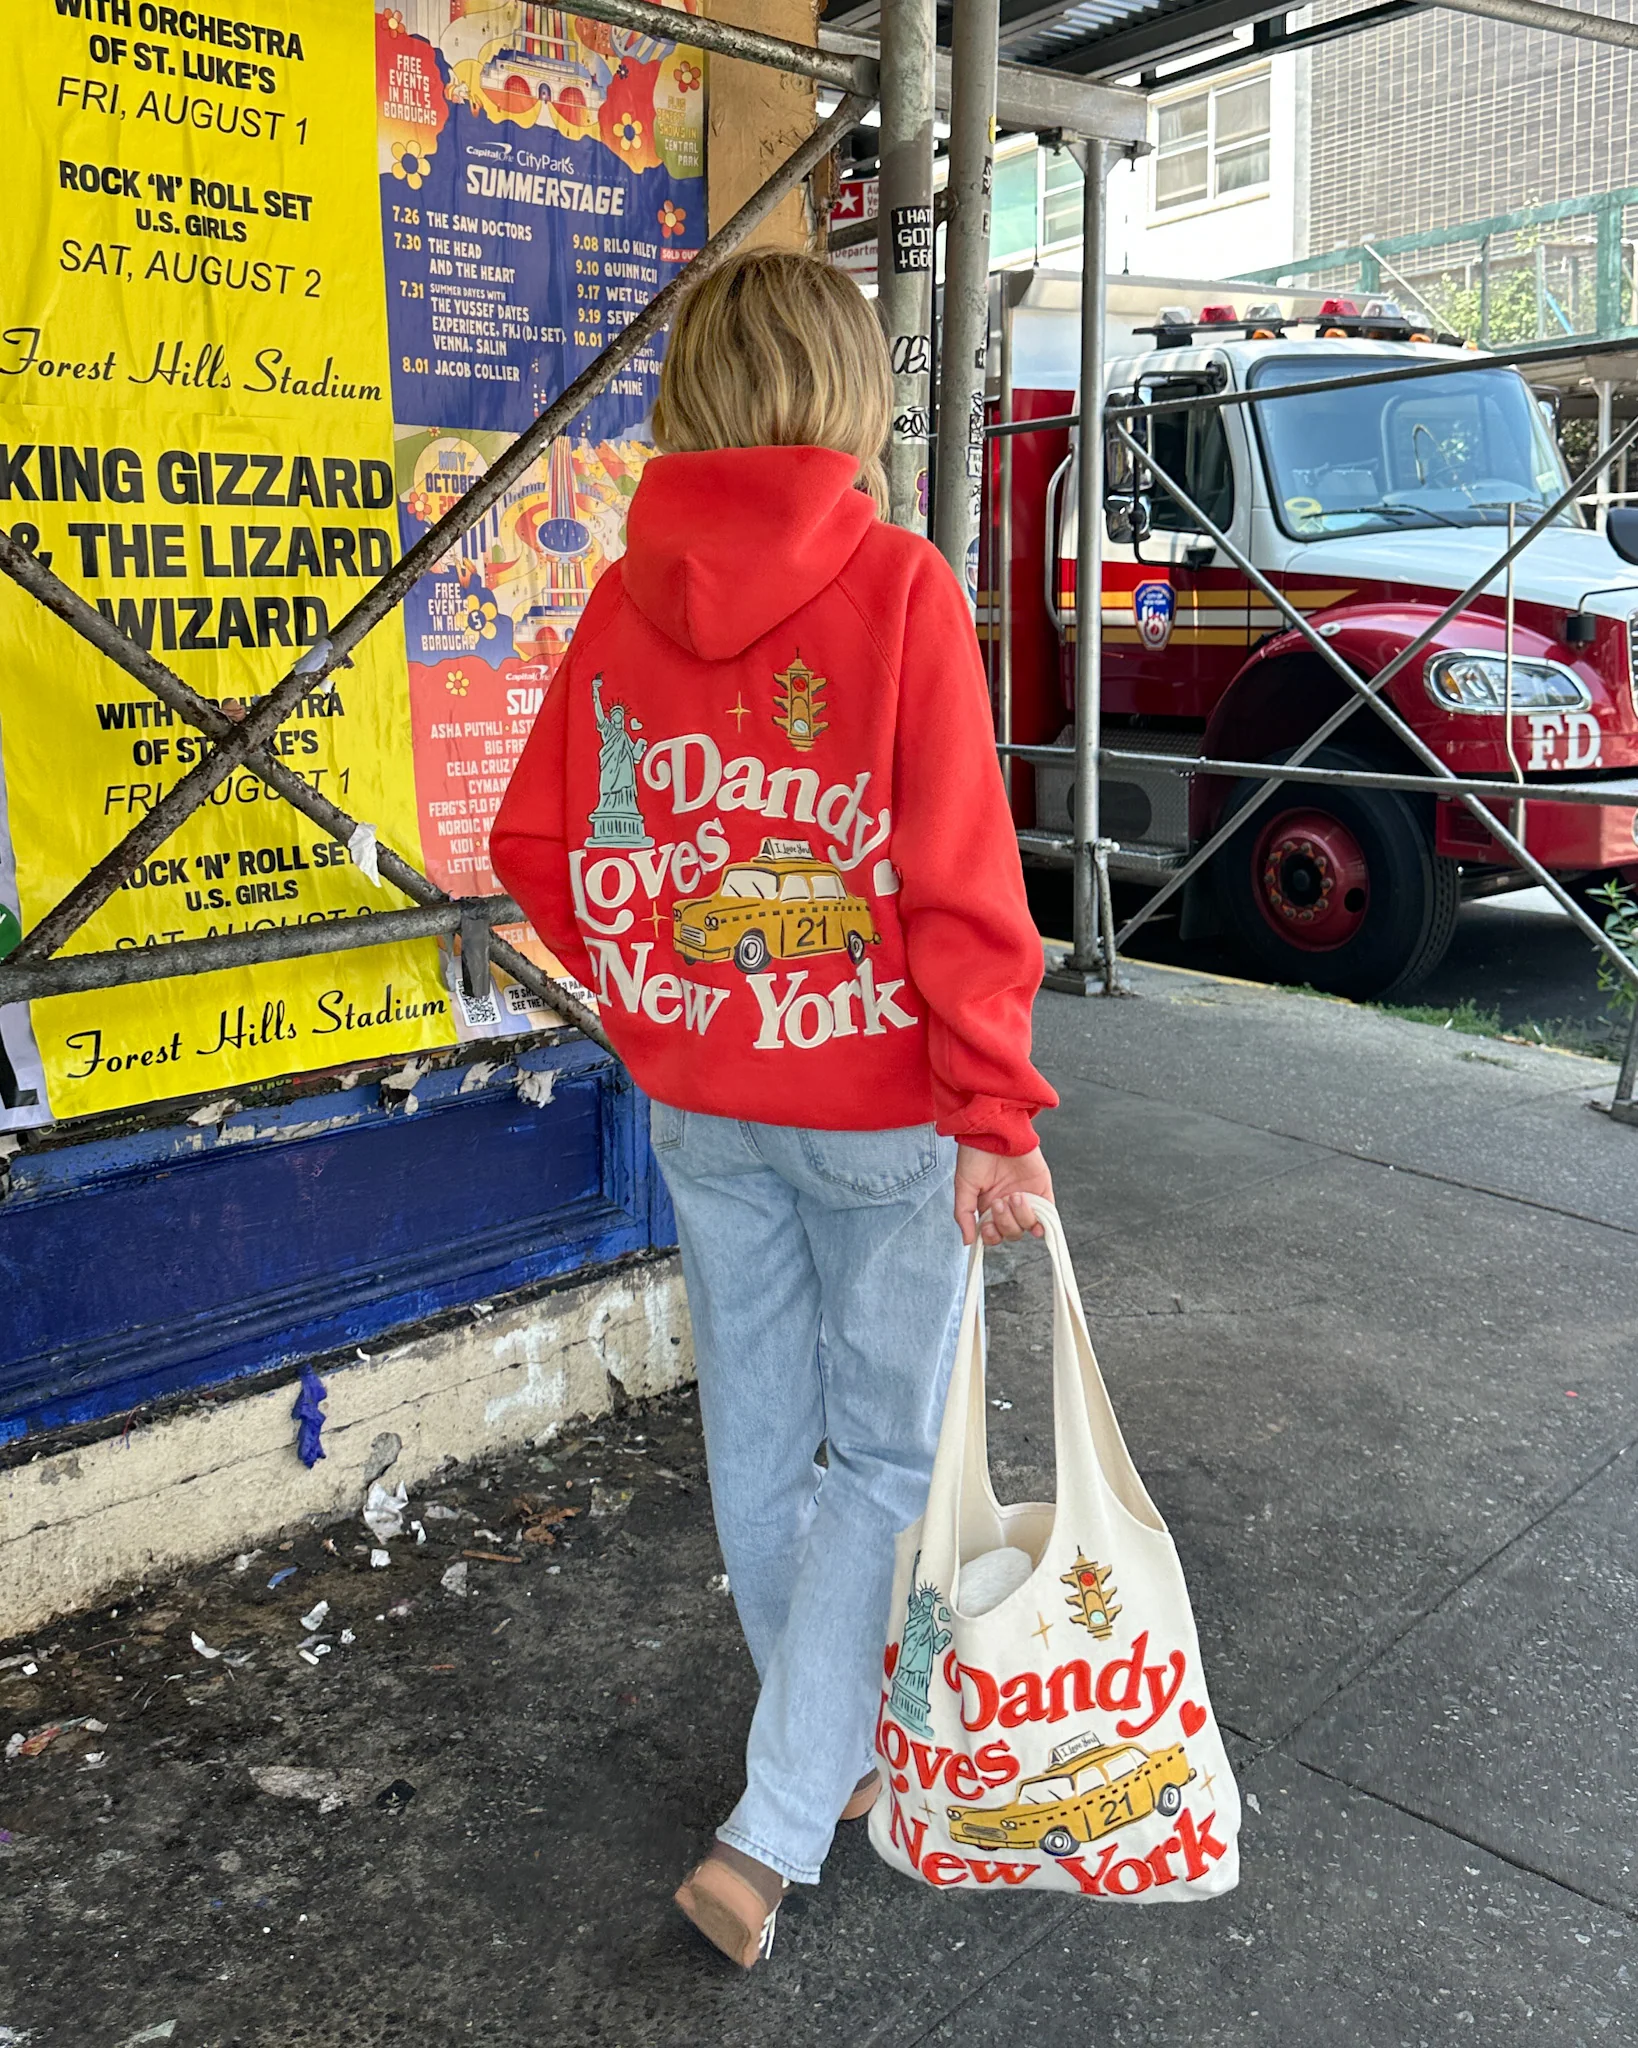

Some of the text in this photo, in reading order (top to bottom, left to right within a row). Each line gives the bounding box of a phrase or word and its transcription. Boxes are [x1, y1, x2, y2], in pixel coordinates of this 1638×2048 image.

[55, 0, 304, 61] WITH ORCHESTRA
[89, 35, 276, 94] OF ST. LUKE'S
[397, 54, 421, 74] FREE
[389, 69, 430, 92] EVENTS
[389, 86, 400, 102] IN
[403, 88, 422, 107] ALL
[57, 76, 308, 145] FRI, AUGUST 1
[383, 102, 437, 126] BOROUGHS
[659, 123, 698, 140] SHOWS IN
[664, 138, 699, 154] CENTRAL
[516, 149, 575, 176] CityParks
[677, 154, 699, 168] PARK
[59, 160, 141, 199] ROCK
[190, 178, 258, 215] ROLL
[264, 192, 313, 222] SET
[466, 163, 625, 217] SUMMERSTAGE
[135, 208, 248, 243] U.S. GIRLS
[392, 205, 533, 242] 7.26 THE SAW DOCTORS
[897, 208, 932, 225] I HAT
[394, 232, 483, 260] 7.30 THE HEAD
[572, 234, 599, 252] 9.08
[603, 237, 631, 255] RILO
[632, 240, 658, 260] KILEY
[662, 249, 681, 261] SOLD
[59, 239, 322, 298] SAT, AUGUST 2
[429, 259, 516, 285] AND THE HEART
[575, 259, 658, 284] 9.10 QUINN XCII
[400, 280, 507, 302] 7.31 SUMMER DAYES WITH
[577, 283, 650, 306] 9.17 WET LEG
[431, 296, 530, 323] THE YUSSEF DAYES
[577, 307, 640, 326] 9.19 SEVE
[432, 315, 500, 337] EXPERIENCE,
[502, 322, 521, 341] FKJ
[522, 324, 539, 344] (DJ
[573, 330, 603, 348] 10.01
[433, 334, 508, 357] VENNA, SALIN
[0, 327, 383, 402] Forest Hills Stadium
[402, 356, 521, 383] 8.01 JACOB COLLIER
[610, 376, 643, 397] AMINÉ
[0, 444, 393, 510] KING GIZZARD
[10, 522, 393, 579] & THE LIZARD
[435, 583, 461, 600] FREE
[428, 599, 469, 616] EVENTS
[96, 596, 330, 652] WIZARD
[433, 611, 483, 633] IN ALL 5
[421, 635, 476, 651] BOROUGHS
[96, 700, 173, 730] WITH
[431, 722, 462, 740] ASHA
[465, 721, 503, 738] PUTHLI
[1527, 712, 1604, 771] F.D.
[133, 739, 169, 766] OF
[176, 736, 213, 763] ST
[484, 738, 528, 756] BIG FRE
[446, 761, 479, 777] CELIA
[481, 759, 510, 775] CRUZ
[104, 782, 162, 815] FRI
[339, 767, 351, 794] 1
[468, 777, 510, 795] CYMAN
[428, 801, 467, 818] FERG'S
[468, 800, 487, 815] FLO
[642, 732, 891, 871] Dandy
[438, 818, 480, 837] NORDIC
[119, 858, 189, 890] OCK
[239, 847, 309, 876] ROLL
[312, 841, 347, 867] SE
[447, 856, 491, 875] LETTUC
[568, 816, 732, 935] Loves
[185, 879, 298, 912] U.S. GIRLS
[796, 916, 828, 948] 21
[583, 936, 732, 1036] New
[511, 1000, 527, 1012] SEE
[528, 997, 543, 1010] THE
[746, 958, 919, 1050] York
[66, 1030, 183, 1078] Forest
[196, 1000, 297, 1055] Hills
[312, 984, 447, 1034] Stadium
[943, 1630, 1187, 1738] Dandy
[1099, 1790, 1137, 1827] 21
[1055, 1806, 1228, 1897] York
